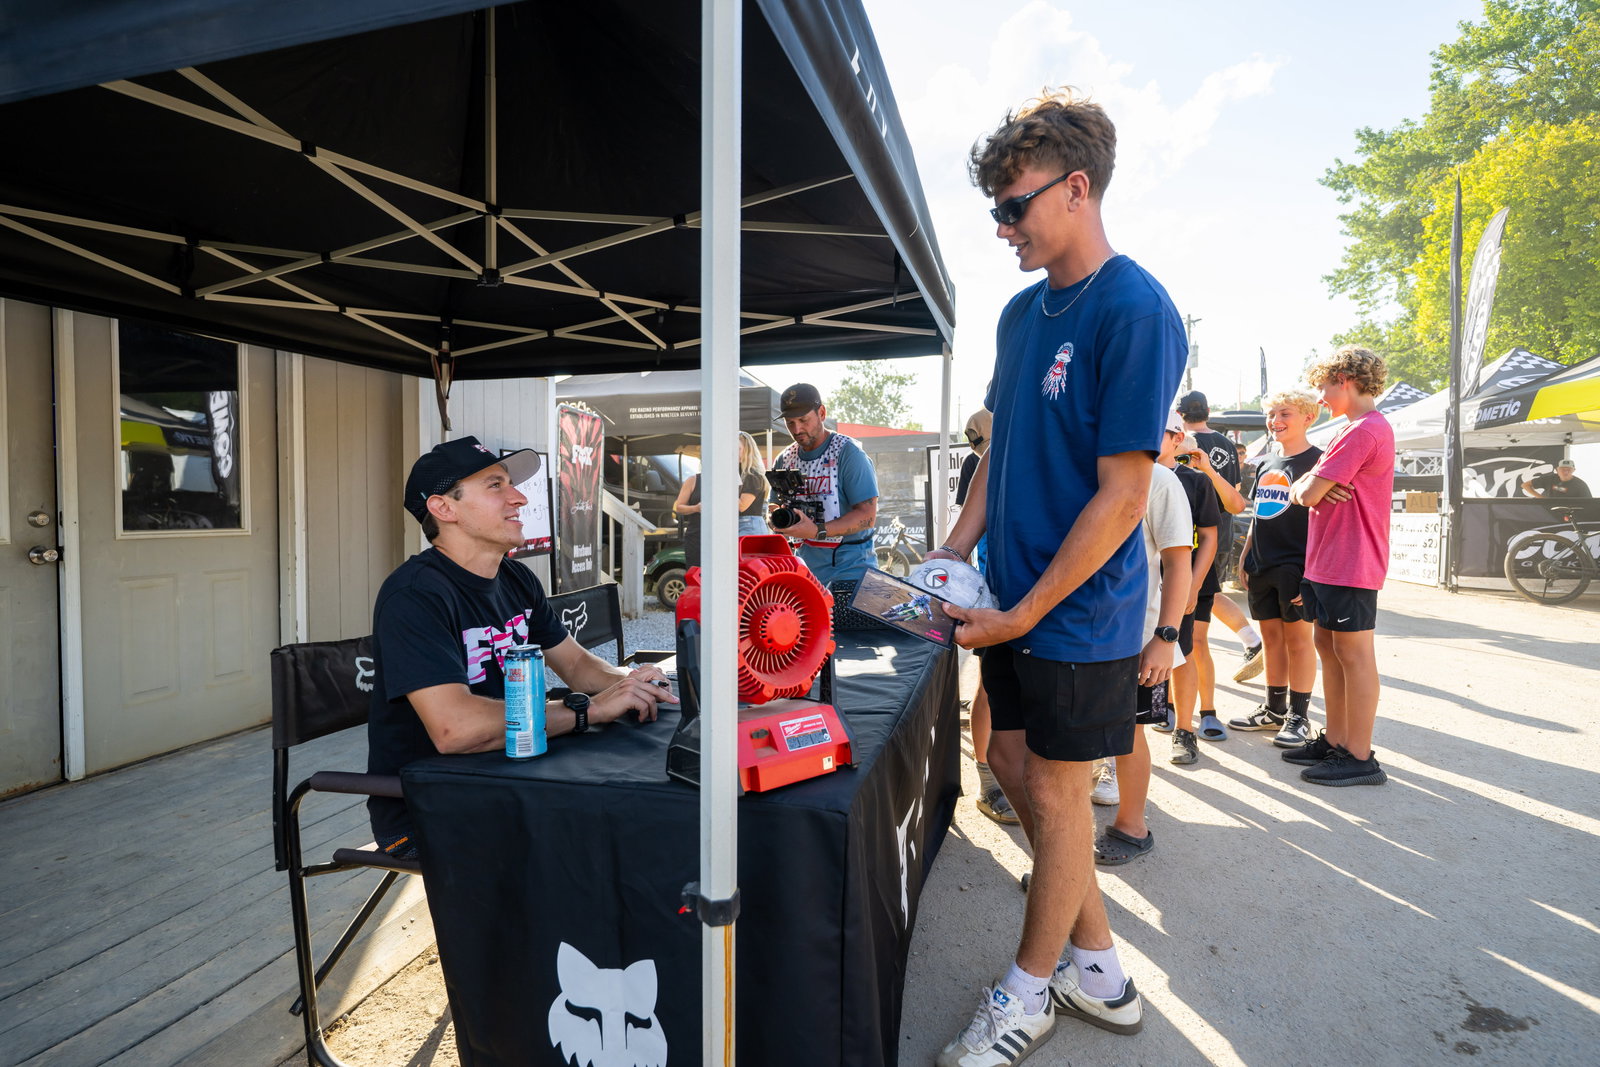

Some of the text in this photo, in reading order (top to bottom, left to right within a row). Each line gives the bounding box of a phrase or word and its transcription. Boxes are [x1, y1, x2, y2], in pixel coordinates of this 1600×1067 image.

[1465, 400, 1521, 424] COMETIC
[1256, 488, 1289, 501] BROWN
[877, 525, 926, 535] MOUTAIN
